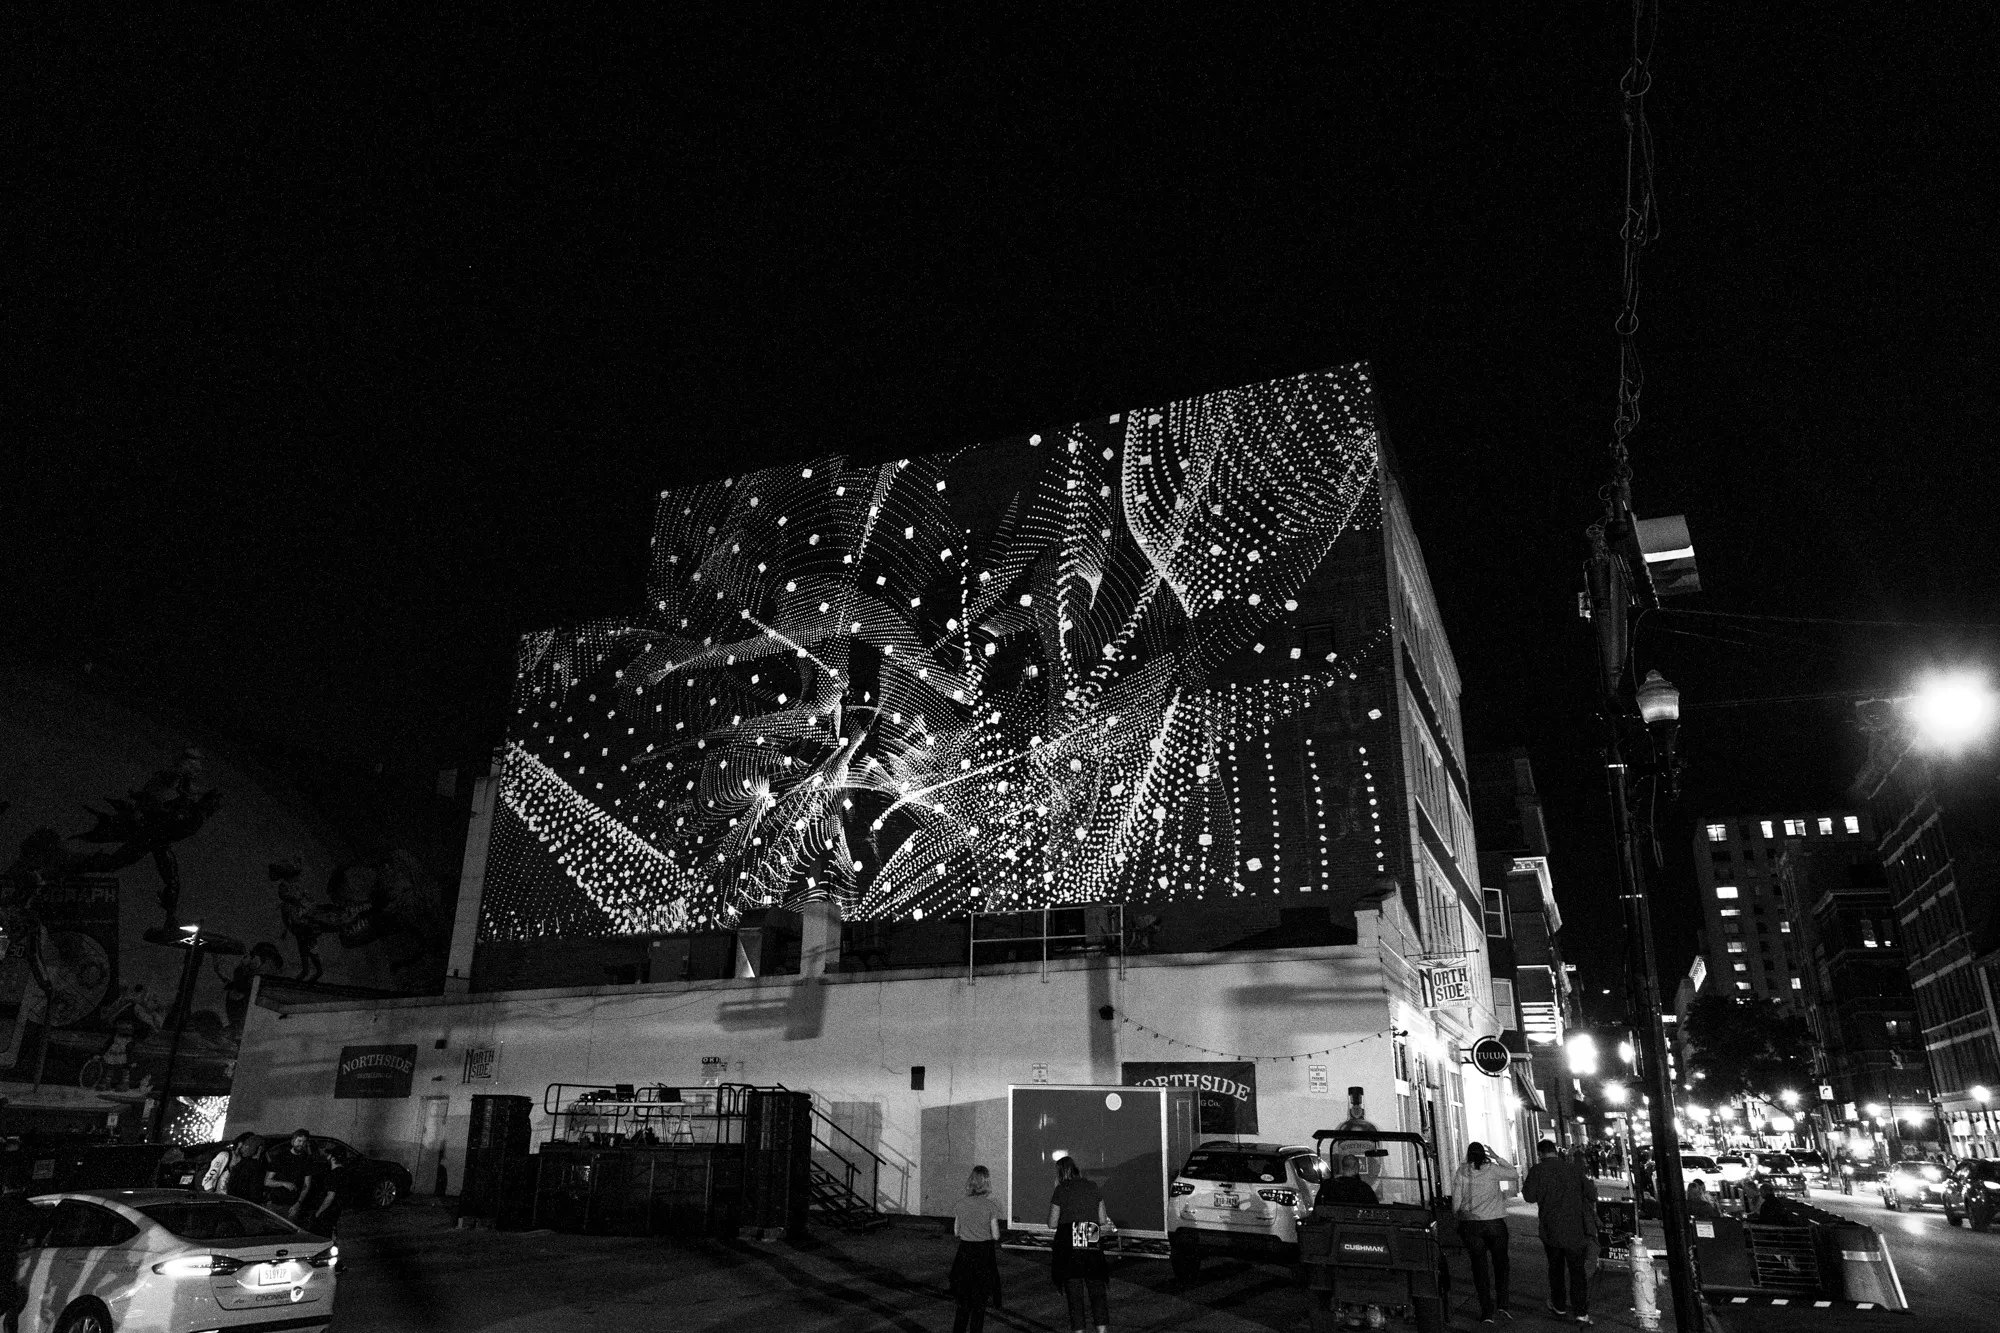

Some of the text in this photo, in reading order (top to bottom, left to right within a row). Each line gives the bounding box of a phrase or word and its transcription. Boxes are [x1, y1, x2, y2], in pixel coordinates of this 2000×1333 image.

[1418, 968, 1468, 1007] NORTH
[1436, 983, 1464, 1001] SIDE
[342, 1054, 412, 1075] NORTHSIDE
[1477, 1052, 1507, 1060] TULUA
[462, 1049, 494, 1083] NORTH
[472, 1064, 490, 1078] SIDE
[1134, 1073, 1250, 1102] ORTHSIDE
[1344, 1244, 1384, 1253] CUSHMAN
